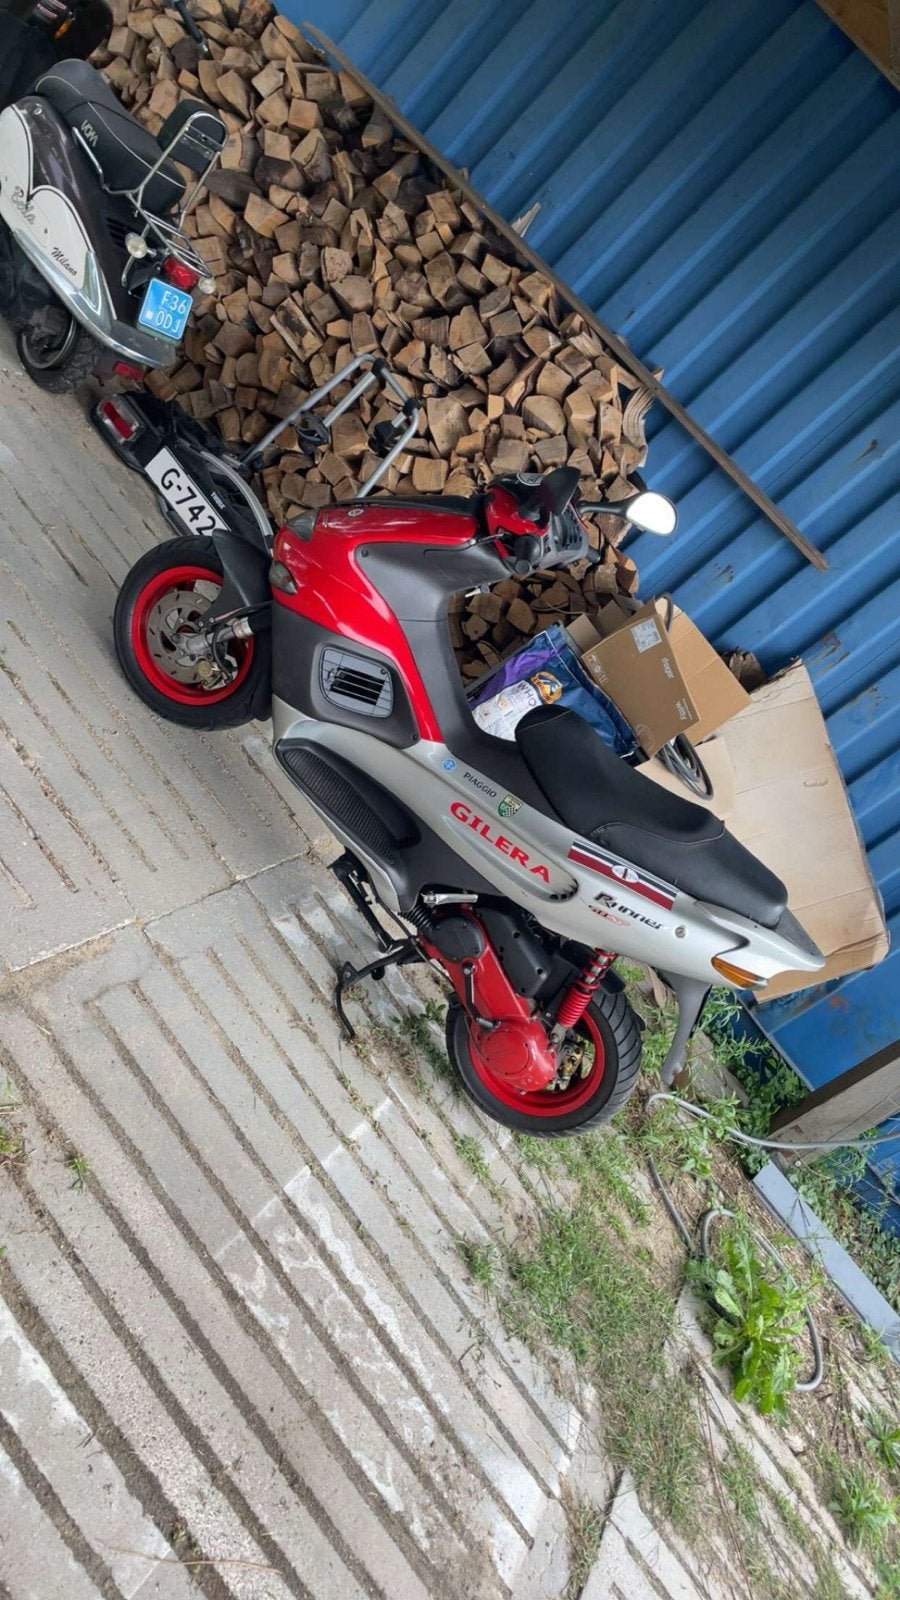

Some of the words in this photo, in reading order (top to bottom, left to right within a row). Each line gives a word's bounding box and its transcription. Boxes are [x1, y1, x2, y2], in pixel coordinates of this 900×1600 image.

[51, 246, 77, 276] Milano
[161, 290, 186, 314] F36
[675, 701, 687, 720] witty
[463, 772, 497, 798] PIAGGIO
[450, 801, 550, 884] GILERA
[594, 893, 664, 930] Runner
